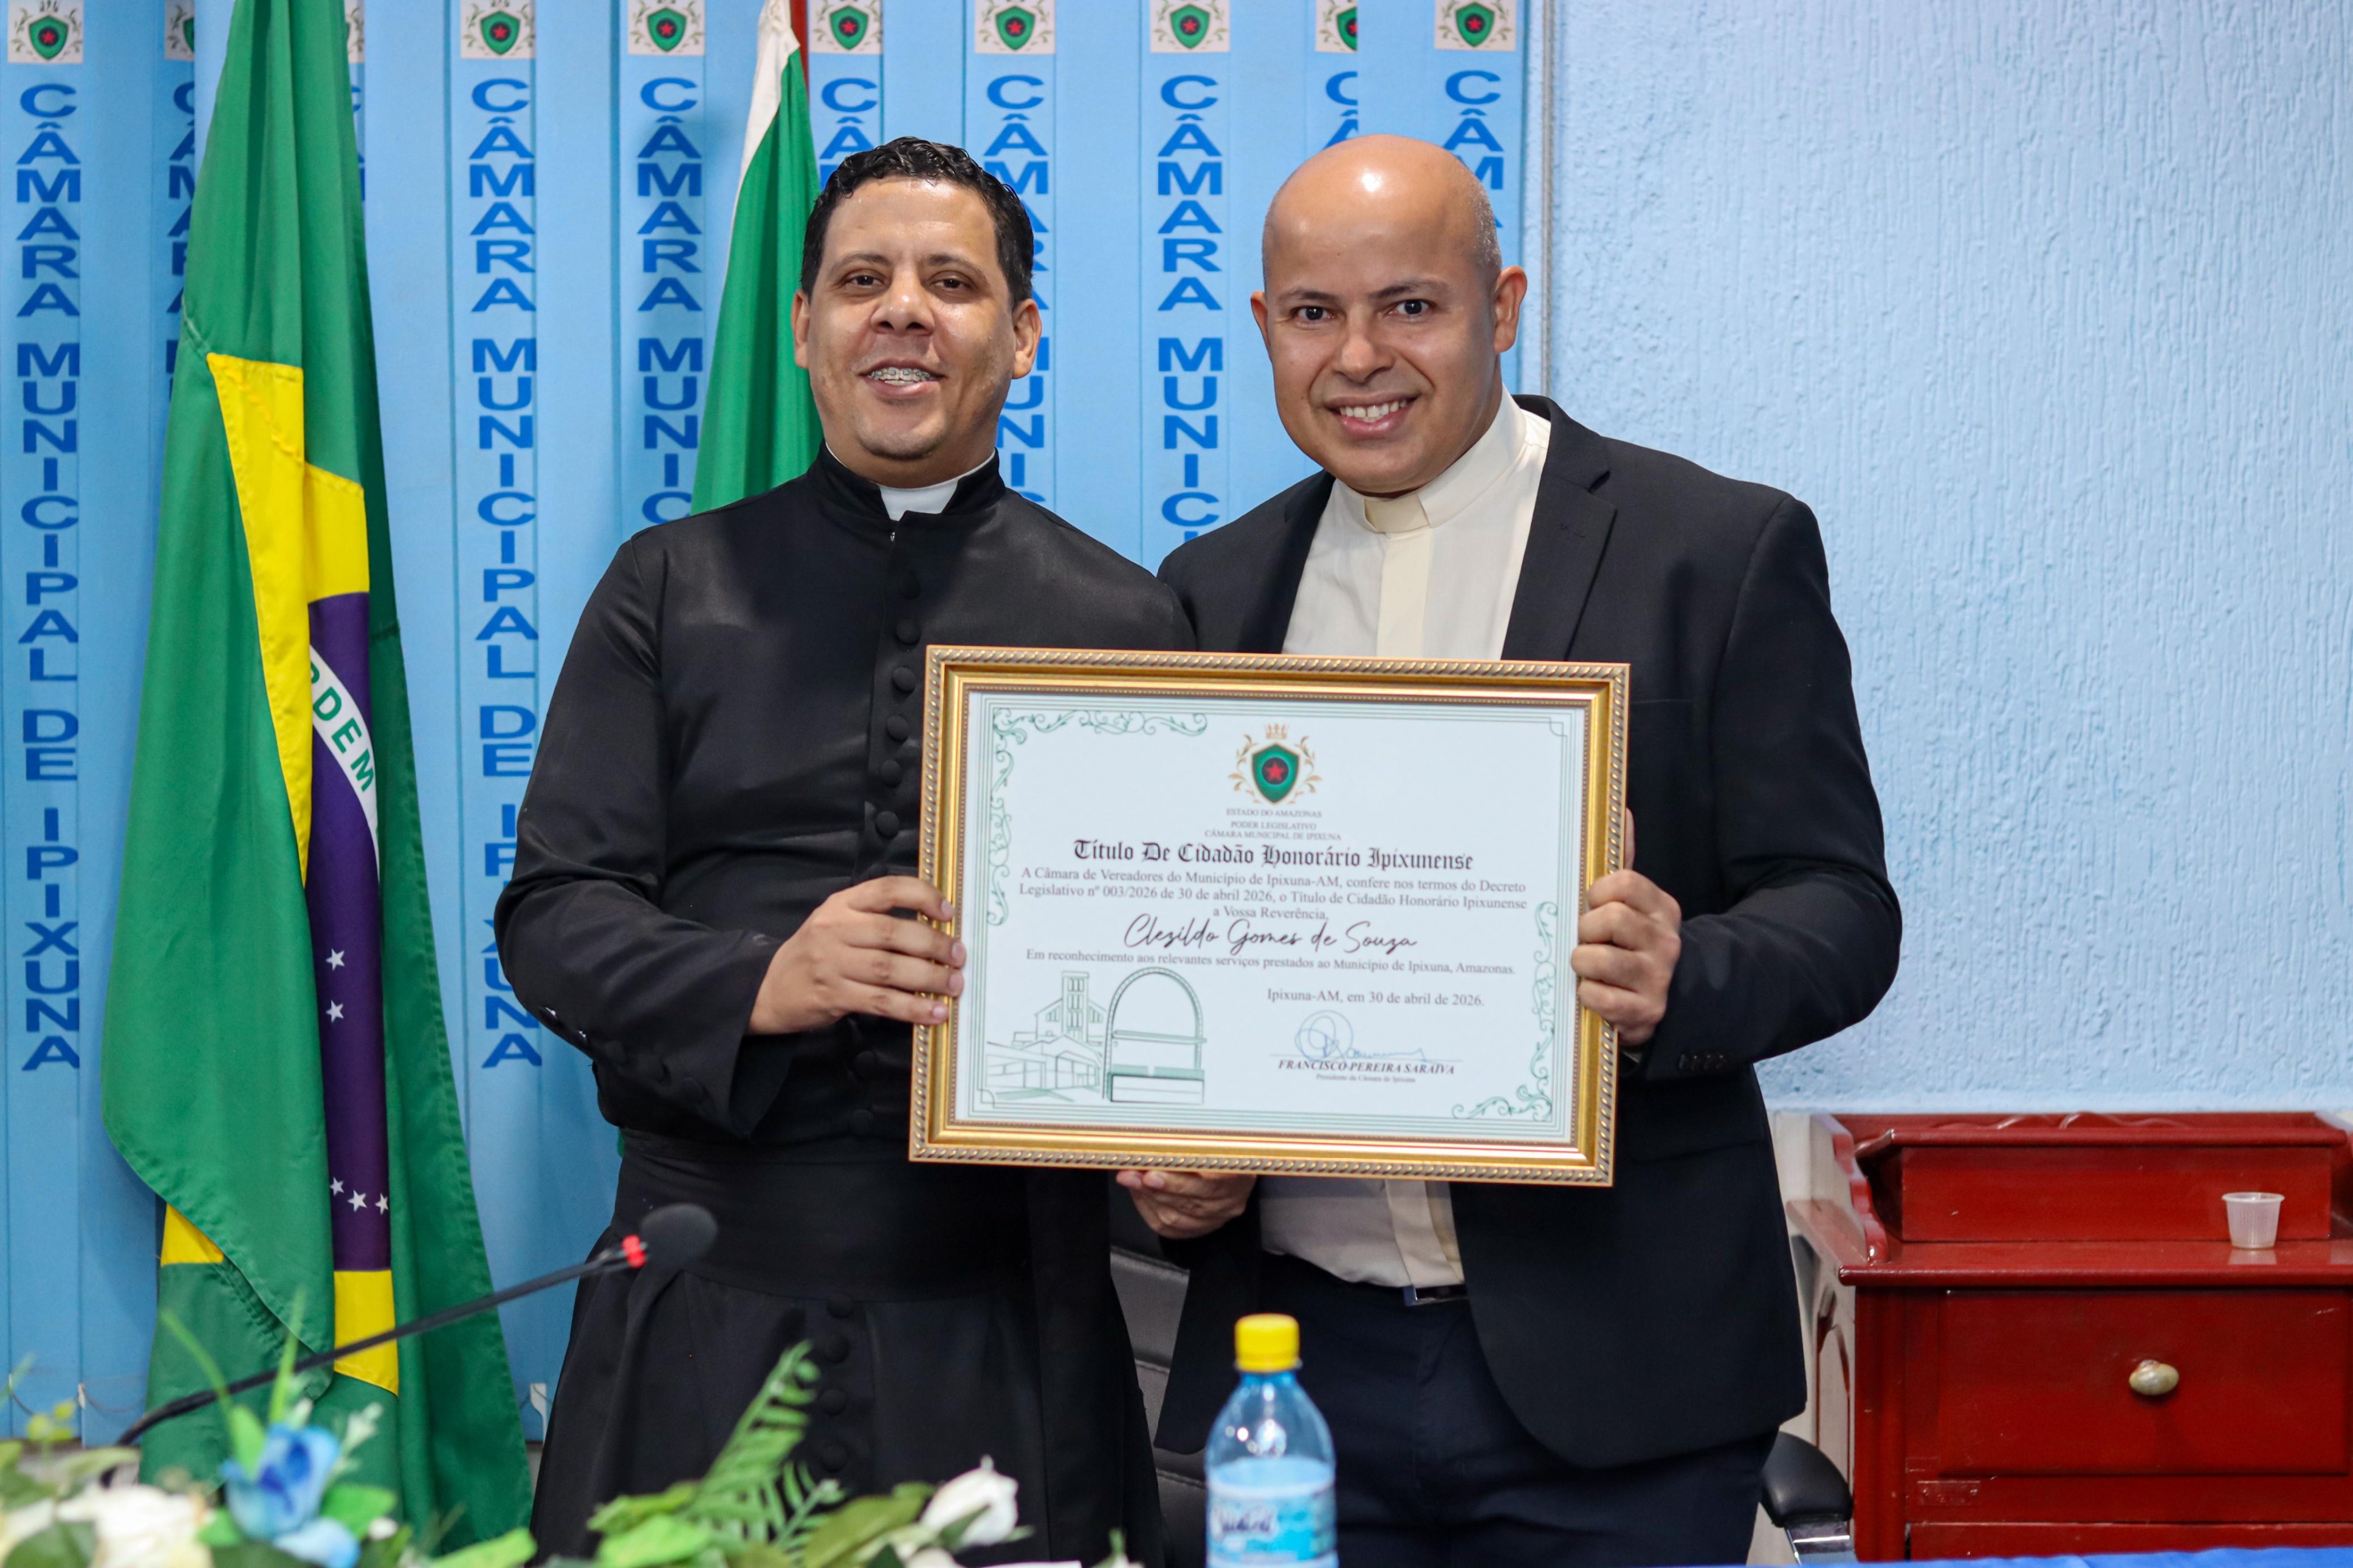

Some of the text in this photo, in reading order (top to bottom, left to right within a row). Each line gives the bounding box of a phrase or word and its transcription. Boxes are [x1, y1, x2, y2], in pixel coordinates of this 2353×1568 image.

[469, 78, 536, 313] CÂMARA
[637, 77, 703, 524] CÂMARA MUNIC
[1157, 75, 1223, 541] CÂMARA MUNIC
[472, 338, 540, 679] MUNICIPAL
[16, 83, 81, 1070] CÂMARA MUNICIPAL DE IPIXUNA
[479, 705, 537, 778] DE
[1226, 807, 1259, 816] ESTADO
[1204, 829, 1243, 838] CÂMARA
[1244, 830, 1291, 839] MUNICIPAL
[1306, 832, 1342, 841] IPIXUNA
[1074, 839, 1474, 871] Título De Cidadão Honorário Ipixunense
[1021, 866, 1527, 893] A Câmara de Vereadores do Município de Ipixuna-AM, confere nos termos do Decreto
[1020, 883, 1085, 898] Legislativo
[1103, 885, 1157, 899] 003/2026
[1160, 887, 1175, 899] de
[1178, 887, 1193, 899] 30
[1196, 888, 1210, 900] de
[1213, 888, 1240, 901] abril
[1243, 889, 1276, 903] 2026,
[1279, 894, 1287, 902] o
[1290, 891, 1327, 903] Título
[1329, 892, 1344, 904] de
[1347, 893, 1396, 906] Cidadão
[1400, 894, 1460, 908] Honorário
[1463, 896, 1527, 911] Ipixunense
[1213, 906, 1329, 922] a Vossa Reverência,
[1227, 918, 1302, 956] Gomes
[1311, 921, 1337, 953] de
[1343, 920, 1418, 954] Souza
[1026, 948, 1516, 974] Em reconhecimento aos relevantes serviços prestados ao Município de Ipixuna, Amazonas.
[1268, 988, 1485, 1007] Ipixuna-AM, em 30 de abril de 2026.
[1278, 1060, 1455, 1075] FRANCISCO PEREIRA SARAIVA
